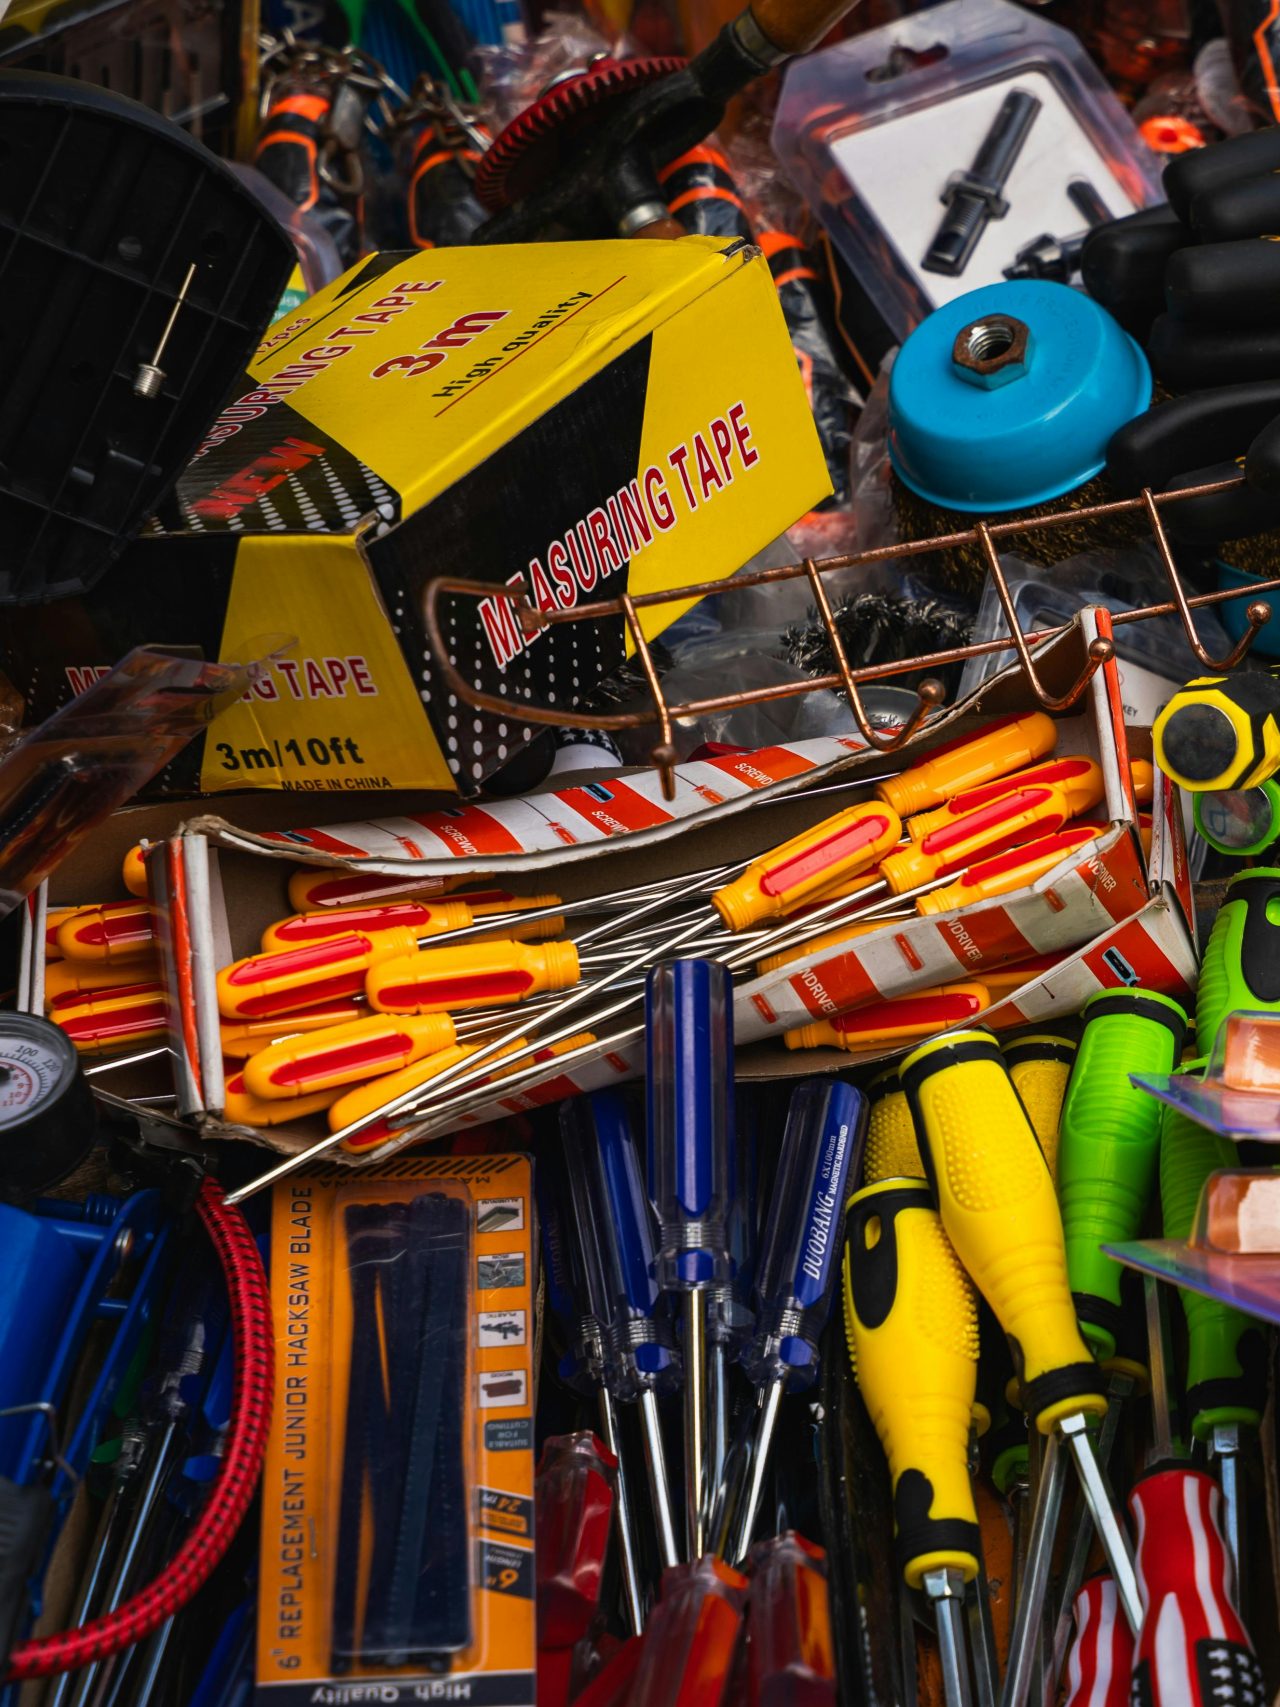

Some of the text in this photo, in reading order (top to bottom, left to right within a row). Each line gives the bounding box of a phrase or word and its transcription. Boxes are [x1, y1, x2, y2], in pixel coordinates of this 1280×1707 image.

[325, 279, 447, 342] TAPE
[369, 309, 513, 380] 3m
[431, 290, 594, 398] High quality
[184, 435, 328, 521] NEW
[667, 399, 760, 511] TAPE
[277, 655, 380, 701] TAPE
[215, 734, 365, 772] 3m/10ft
[281, 777, 326, 792] MADE
[344, 775, 393, 791] CHINA
[15, 1045, 38, 1057] 100
[822, 1135, 837, 1179] 6X100mm
[828, 1124, 849, 1195] MAGNETIC HARDENED
[802, 1191, 835, 1281] DUOBANG
[270, 1187, 313, 1670] 6" REPLACEMENT JUNIOR HACKSAW BLADE
[487, 1420, 529, 1431] CUTTING
[488, 1438, 529, 1449] SUITABLE
[497, 1431, 519, 1439] FOR
[311, 1681, 472, 1705] High Quality
